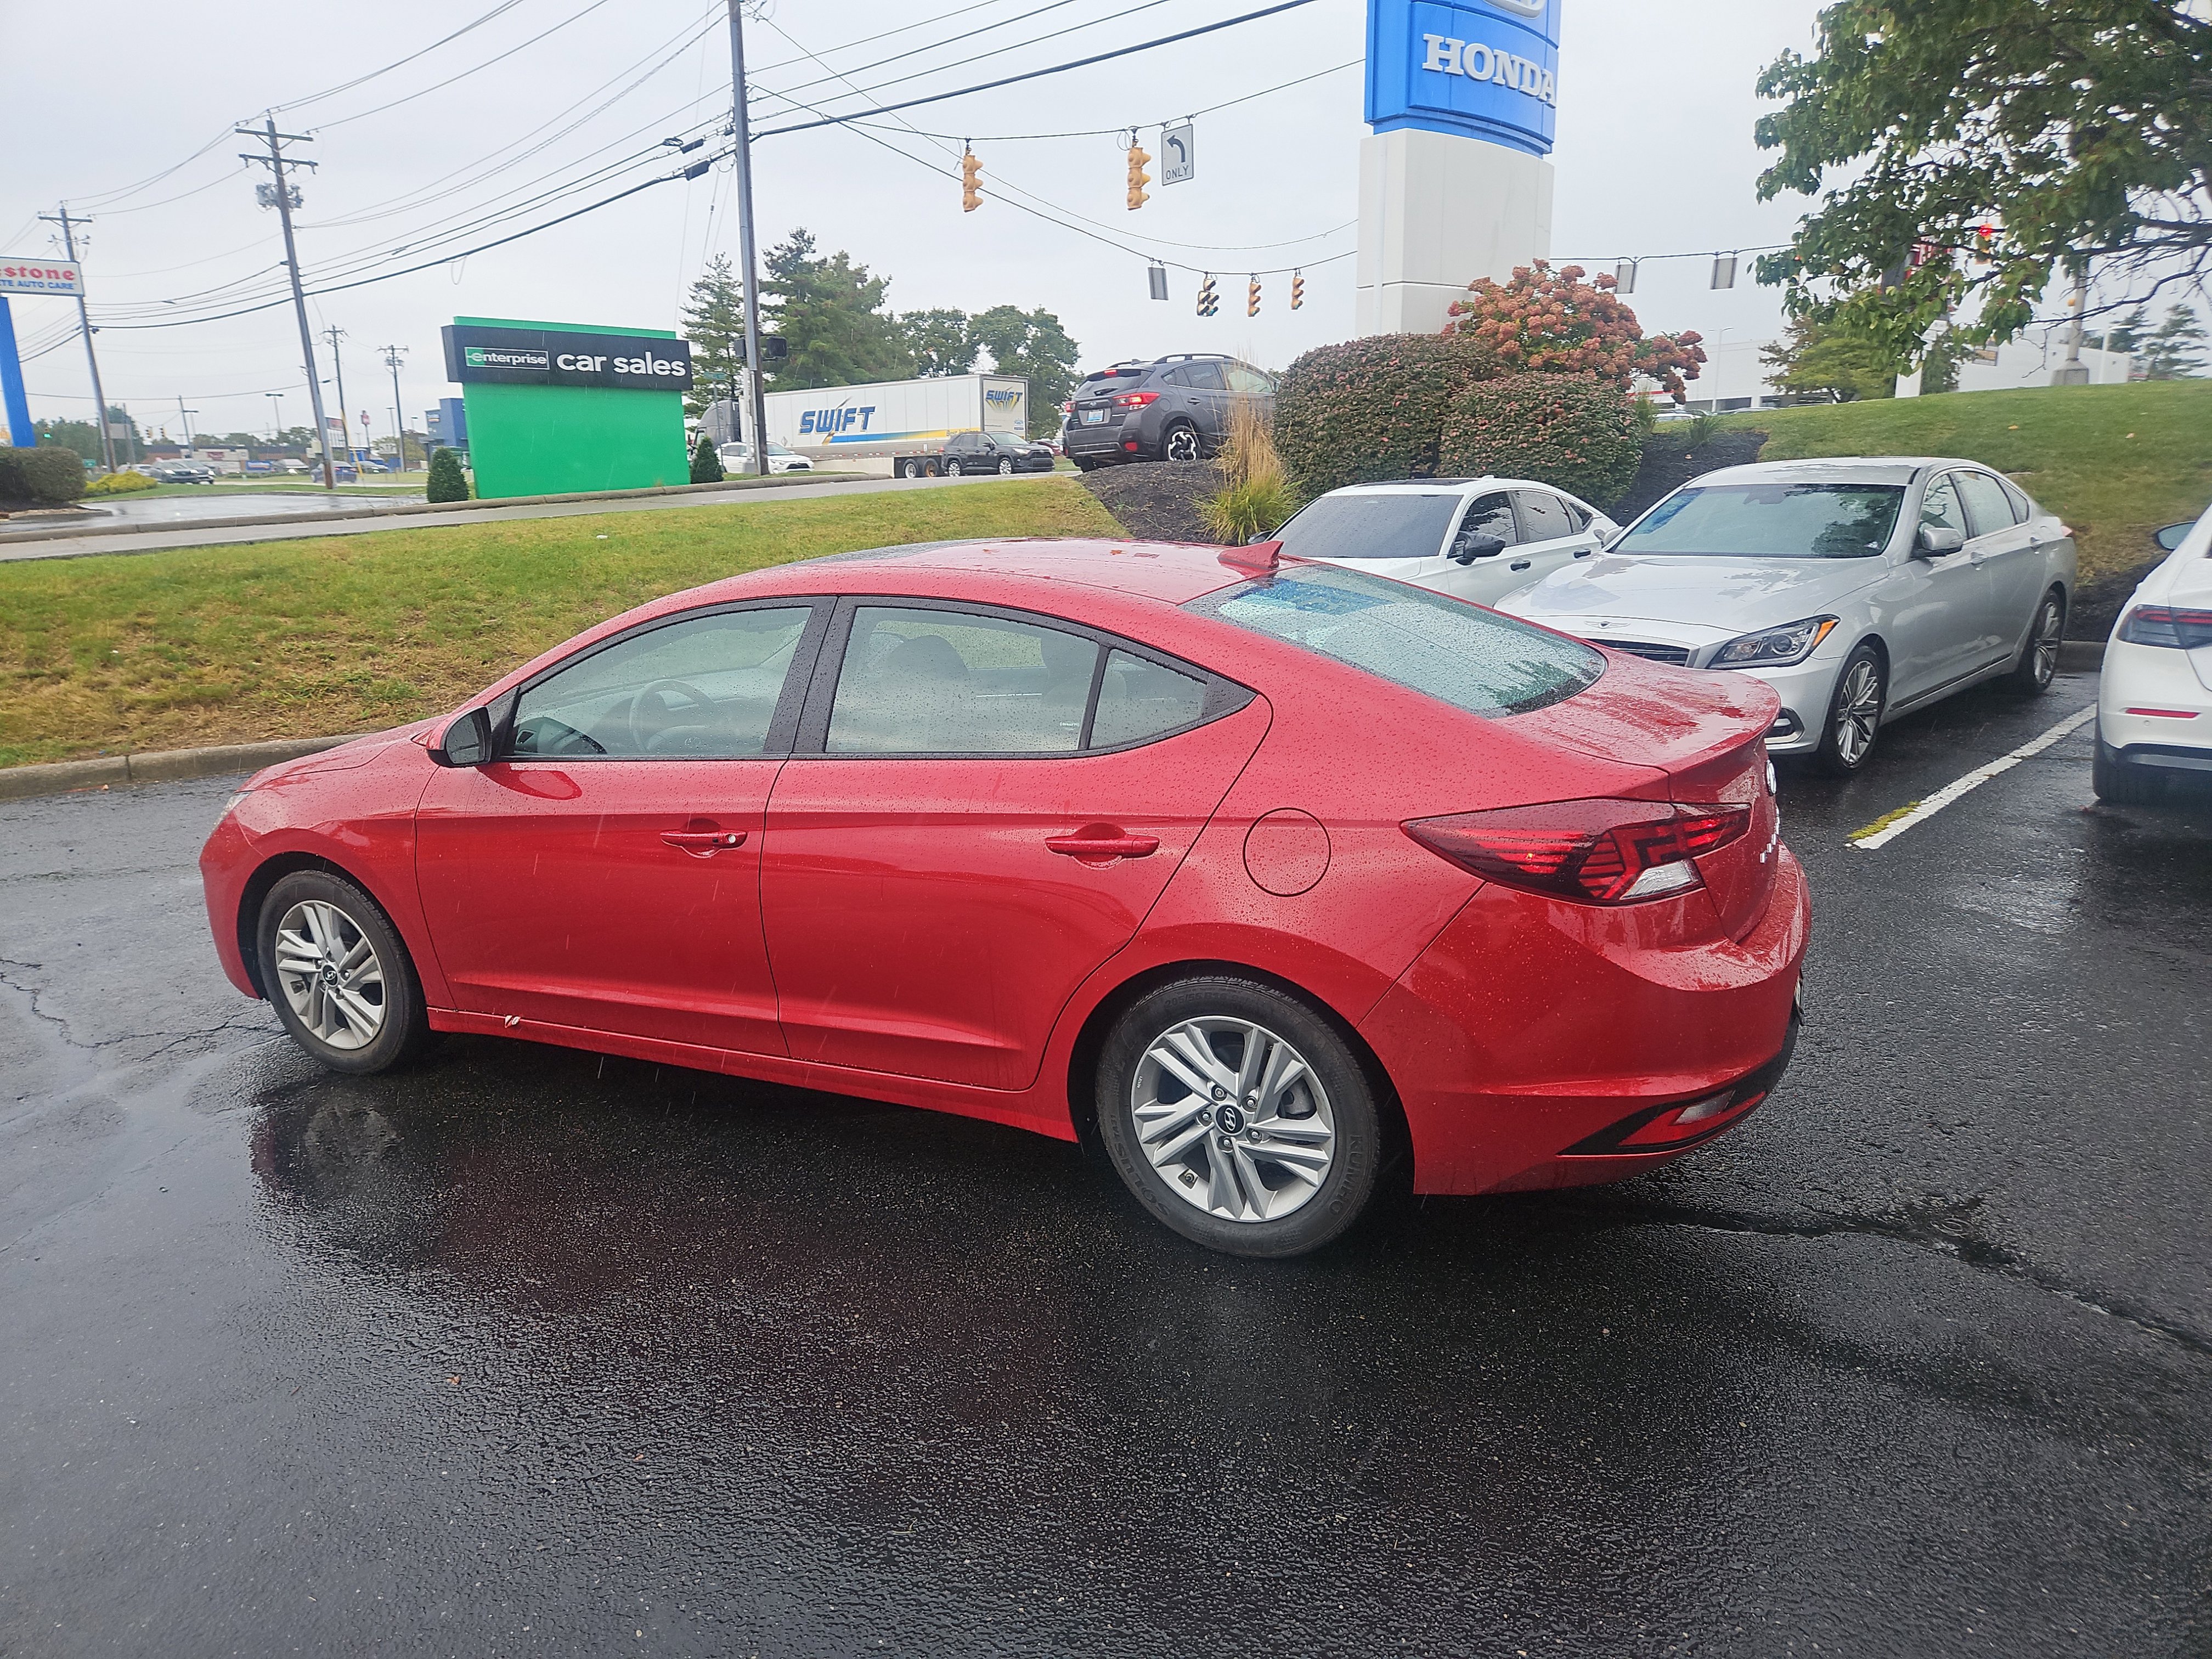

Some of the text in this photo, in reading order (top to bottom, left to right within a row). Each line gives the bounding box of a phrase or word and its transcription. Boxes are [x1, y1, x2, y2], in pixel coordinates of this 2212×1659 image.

[1422, 33, 1556, 109] HONDA
[1166, 165, 1189, 179] ONLY
[0, 266, 75, 280] stone
[471, 352, 547, 365] enterprise
[556, 351, 686, 376] car sales
[986, 390, 1023, 402] SWIFT
[799, 406, 876, 435] SWIFT
[1115, 1142, 1171, 1216] SOLUS
[1329, 1135, 1363, 1214] KUMHO
